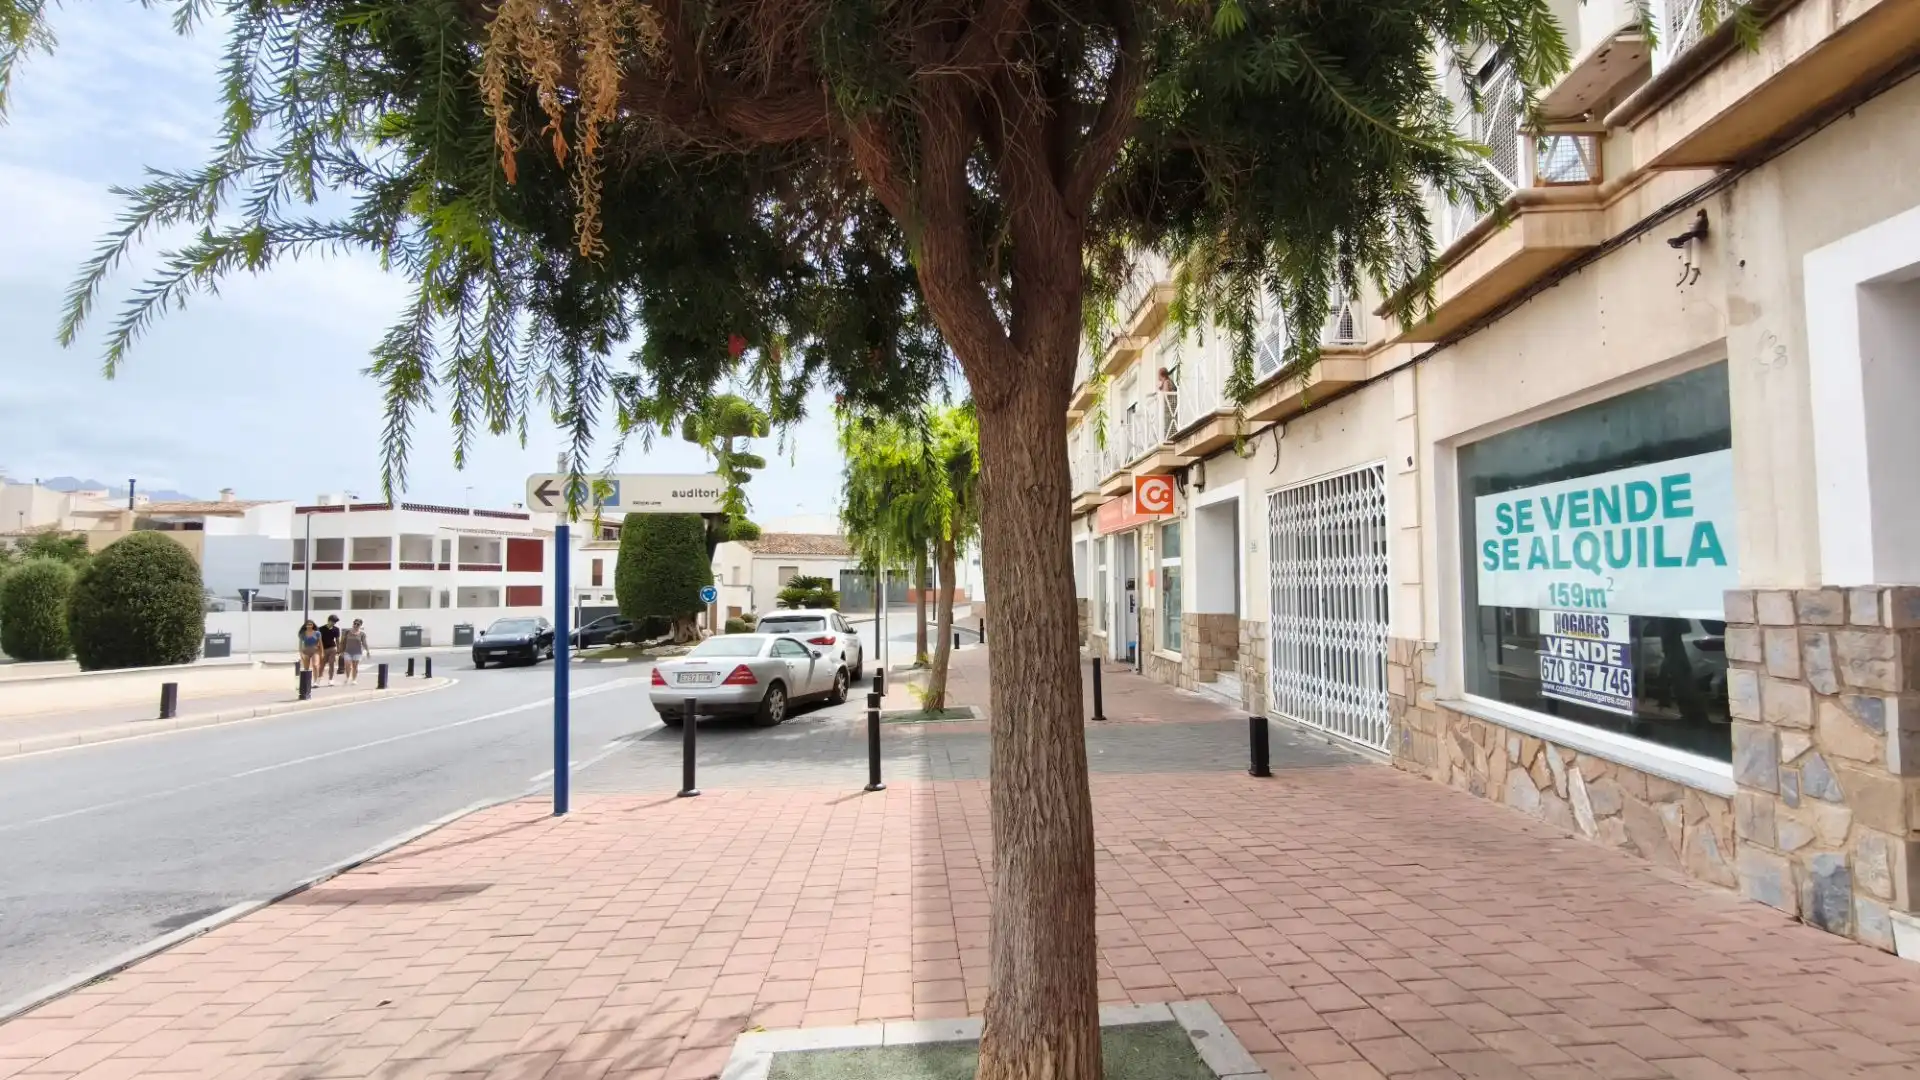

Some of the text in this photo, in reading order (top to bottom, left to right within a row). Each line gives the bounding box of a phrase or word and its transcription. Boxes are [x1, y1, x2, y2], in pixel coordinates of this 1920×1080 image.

[671, 488, 719, 498] auditori
[1496, 472, 1694, 536] SE VENDE
[1482, 520, 1727, 576] SE ALQUILA
[1553, 612, 1610, 639] HOGARES
[1545, 636, 1622, 666] VENDE
[1541, 657, 1630, 696] 670 857 746
